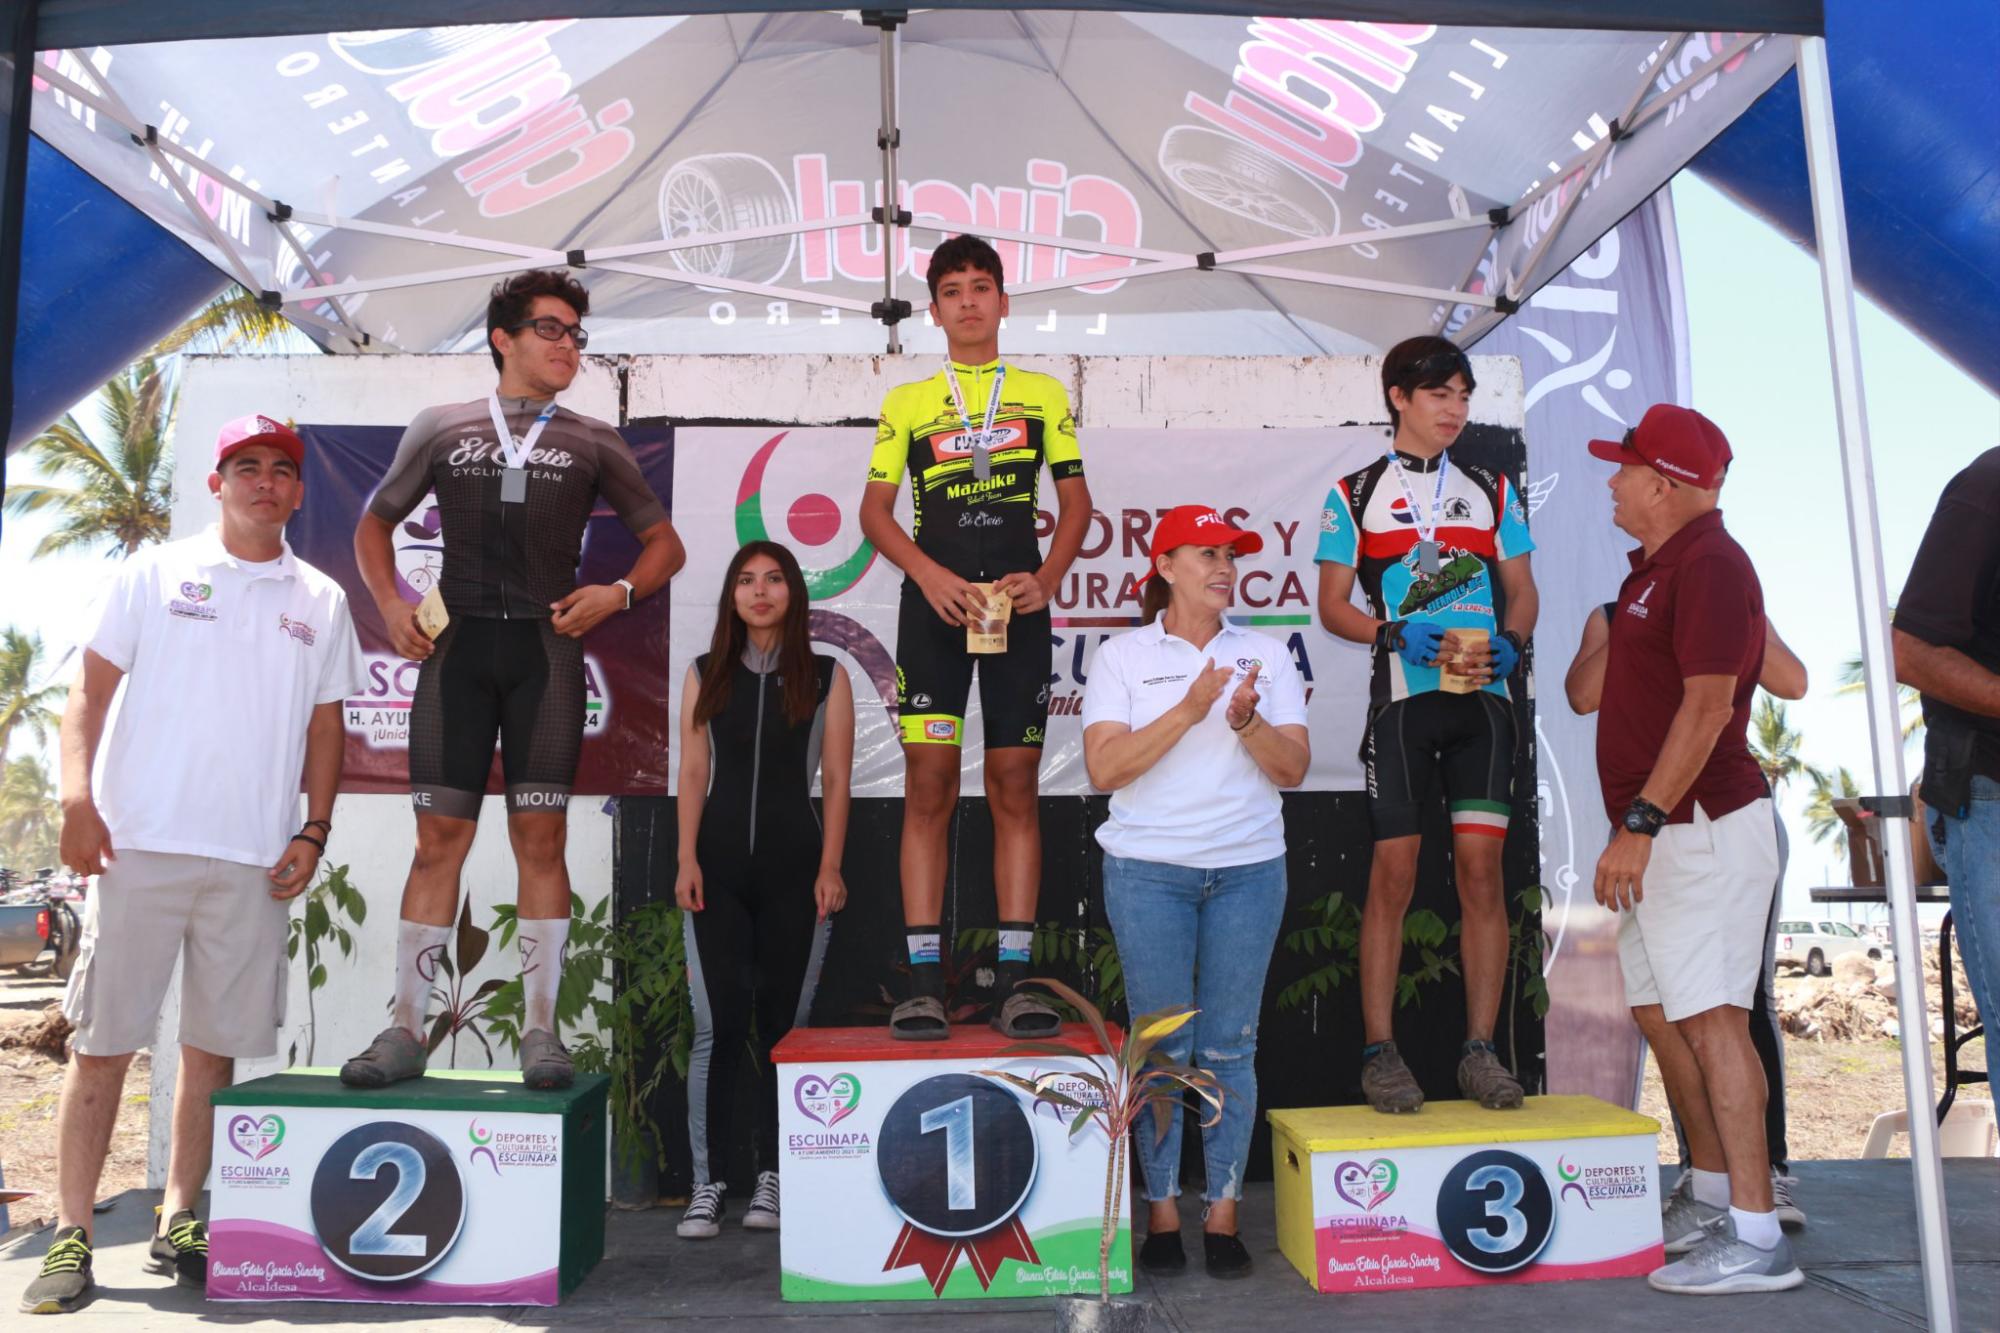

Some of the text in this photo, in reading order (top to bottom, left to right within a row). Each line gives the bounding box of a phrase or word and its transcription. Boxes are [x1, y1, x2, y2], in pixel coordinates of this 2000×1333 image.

[452, 467, 562, 482] CYCLIN TEAM
[1272, 520, 1300, 556] Y
[350, 711, 366, 726] H.
[1368, 761, 1379, 799] rate
[496, 1133, 557, 1144] DEPORTES Y
[788, 1133, 870, 1147] ESCUINAPA
[496, 1144, 530, 1152] CULTURA
[920, 1095, 976, 1211] 1
[499, 1153, 557, 1163] ESCUINAPA
[221, 1166, 290, 1178] ESCUINAPA
[1585, 1165, 1645, 1177] DEPORTES Y
[1585, 1177, 1619, 1186] CULTURA
[1589, 1184, 1647, 1196] ESCUINAPA
[349, 1141, 428, 1257] 2
[1466, 1165, 1528, 1254] 3
[1330, 1216, 1408, 1232] ESCUINAPA
[212, 1261, 240, 1277] Blanca
[1328, 1257, 1356, 1274] Blanca
[1016, 1268, 1043, 1283] Blanca
[1354, 1274, 1414, 1287] Alcaldesa
[236, 1281, 297, 1292] Alcaldesa
